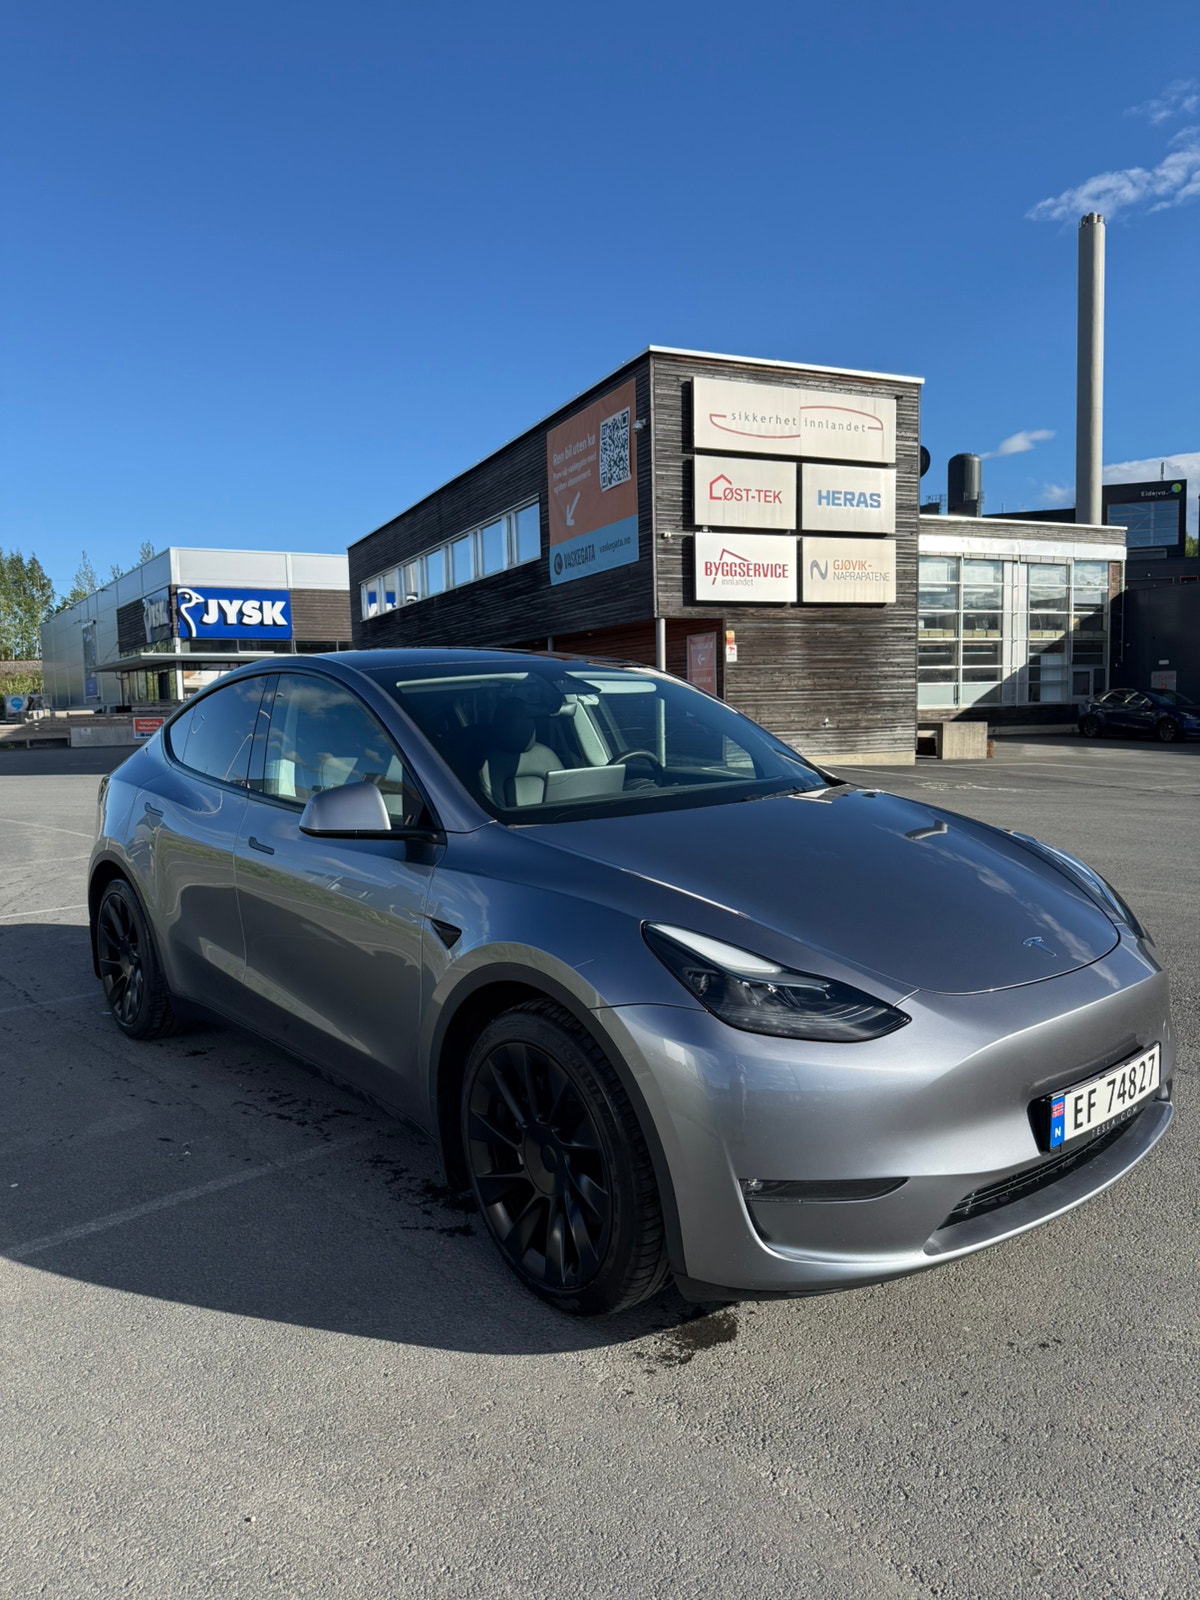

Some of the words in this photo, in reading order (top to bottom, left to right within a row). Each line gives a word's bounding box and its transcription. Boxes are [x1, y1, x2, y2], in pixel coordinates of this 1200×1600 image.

[731, 410, 797, 426] sikkerhet
[804, 417, 866, 432] innlandet
[818, 489, 881, 509] HERAS
[599, 536, 631, 553] vaskegata.no
[563, 544, 596, 569] VASKEGATA
[833, 559, 872, 571] GJØVIK-
[704, 560, 789, 580] BYGGSERVICE
[833, 571, 891, 582] NAPRAPATENE
[721, 578, 754, 587] innlandet
[202, 599, 288, 626] JYSK
[1074, 1087, 1097, 1130] EF
[1107, 1053, 1155, 1114] 74827
[1054, 1126, 1062, 1138] N
[1091, 1106, 1139, 1138] TESLA.COM
